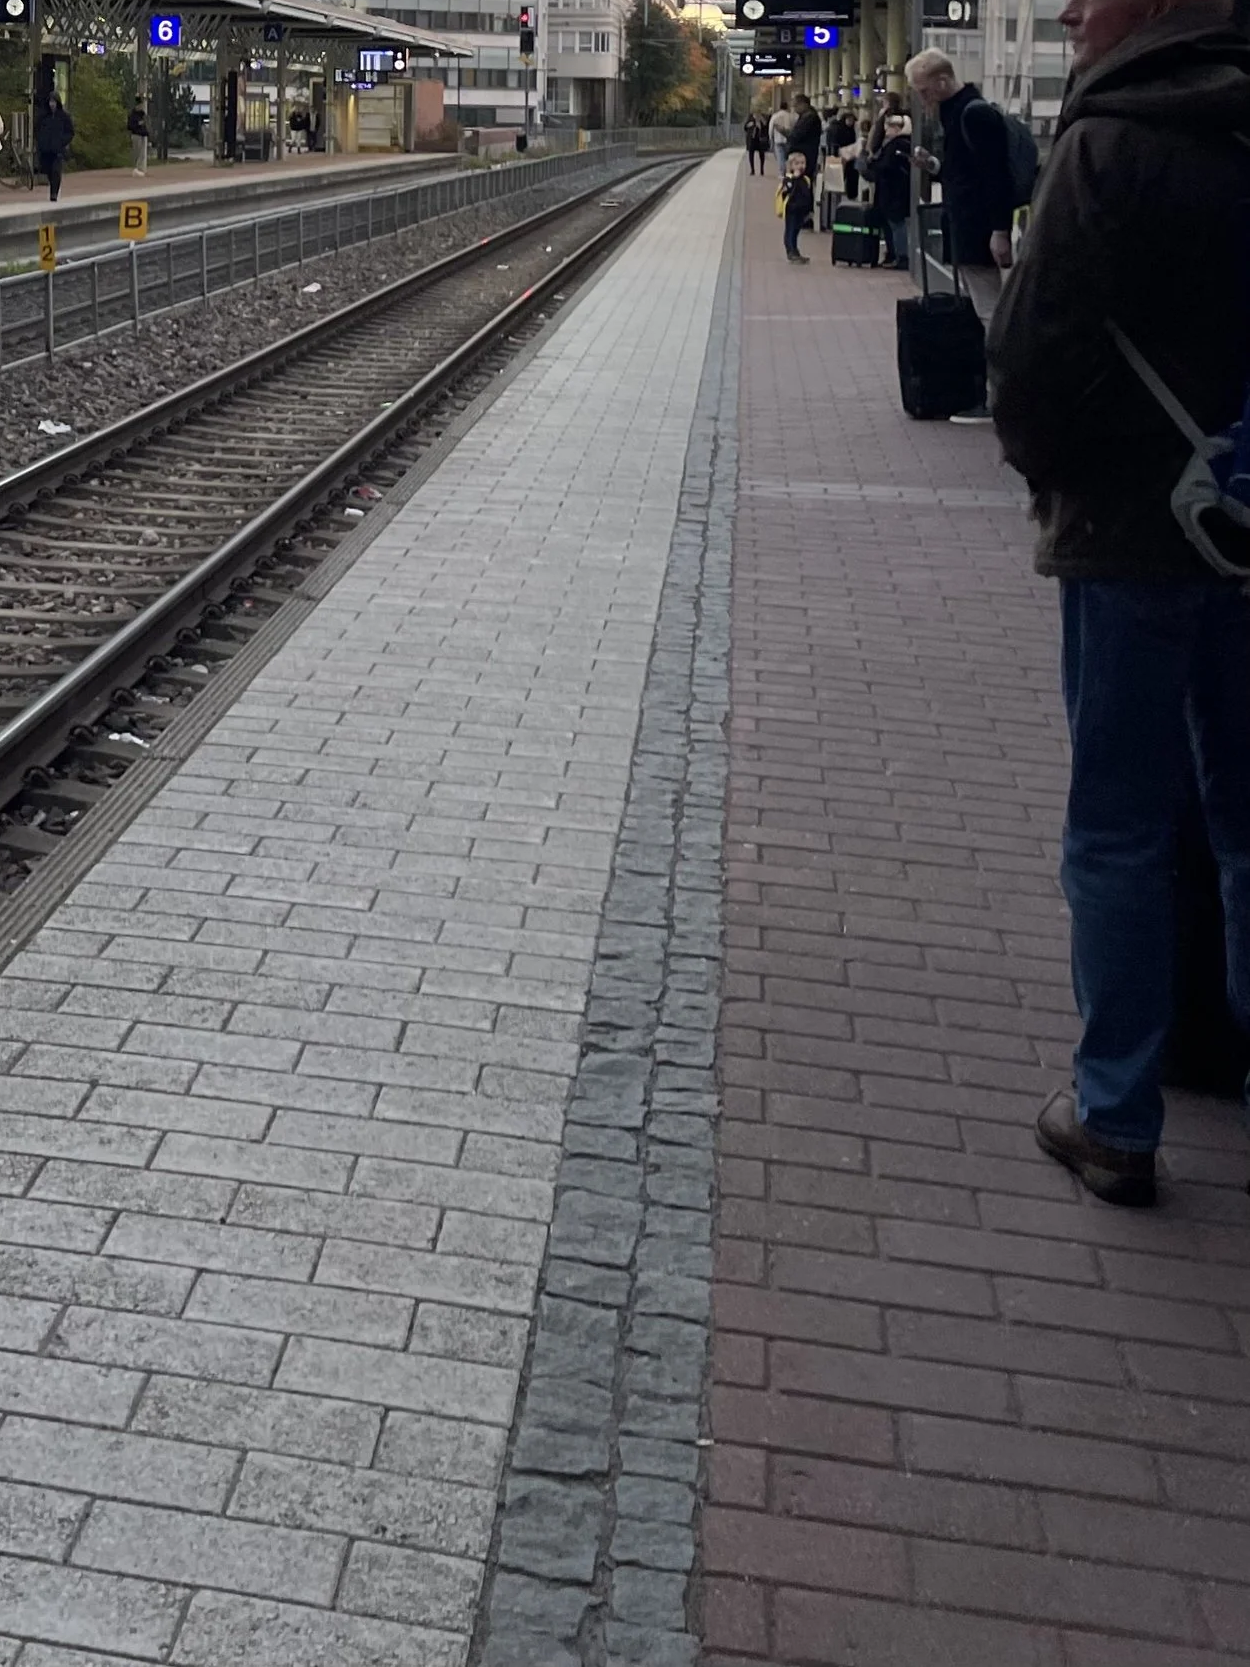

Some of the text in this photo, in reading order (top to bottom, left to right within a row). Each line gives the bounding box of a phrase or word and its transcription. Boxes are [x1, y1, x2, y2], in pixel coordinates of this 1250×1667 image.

[158, 20, 173, 41] 6
[268, 28, 278, 40] A
[814, 26, 831, 44] 5
[124, 206, 143, 229] B
[42, 226, 50, 242] 1
[43, 245, 53, 262] 2
